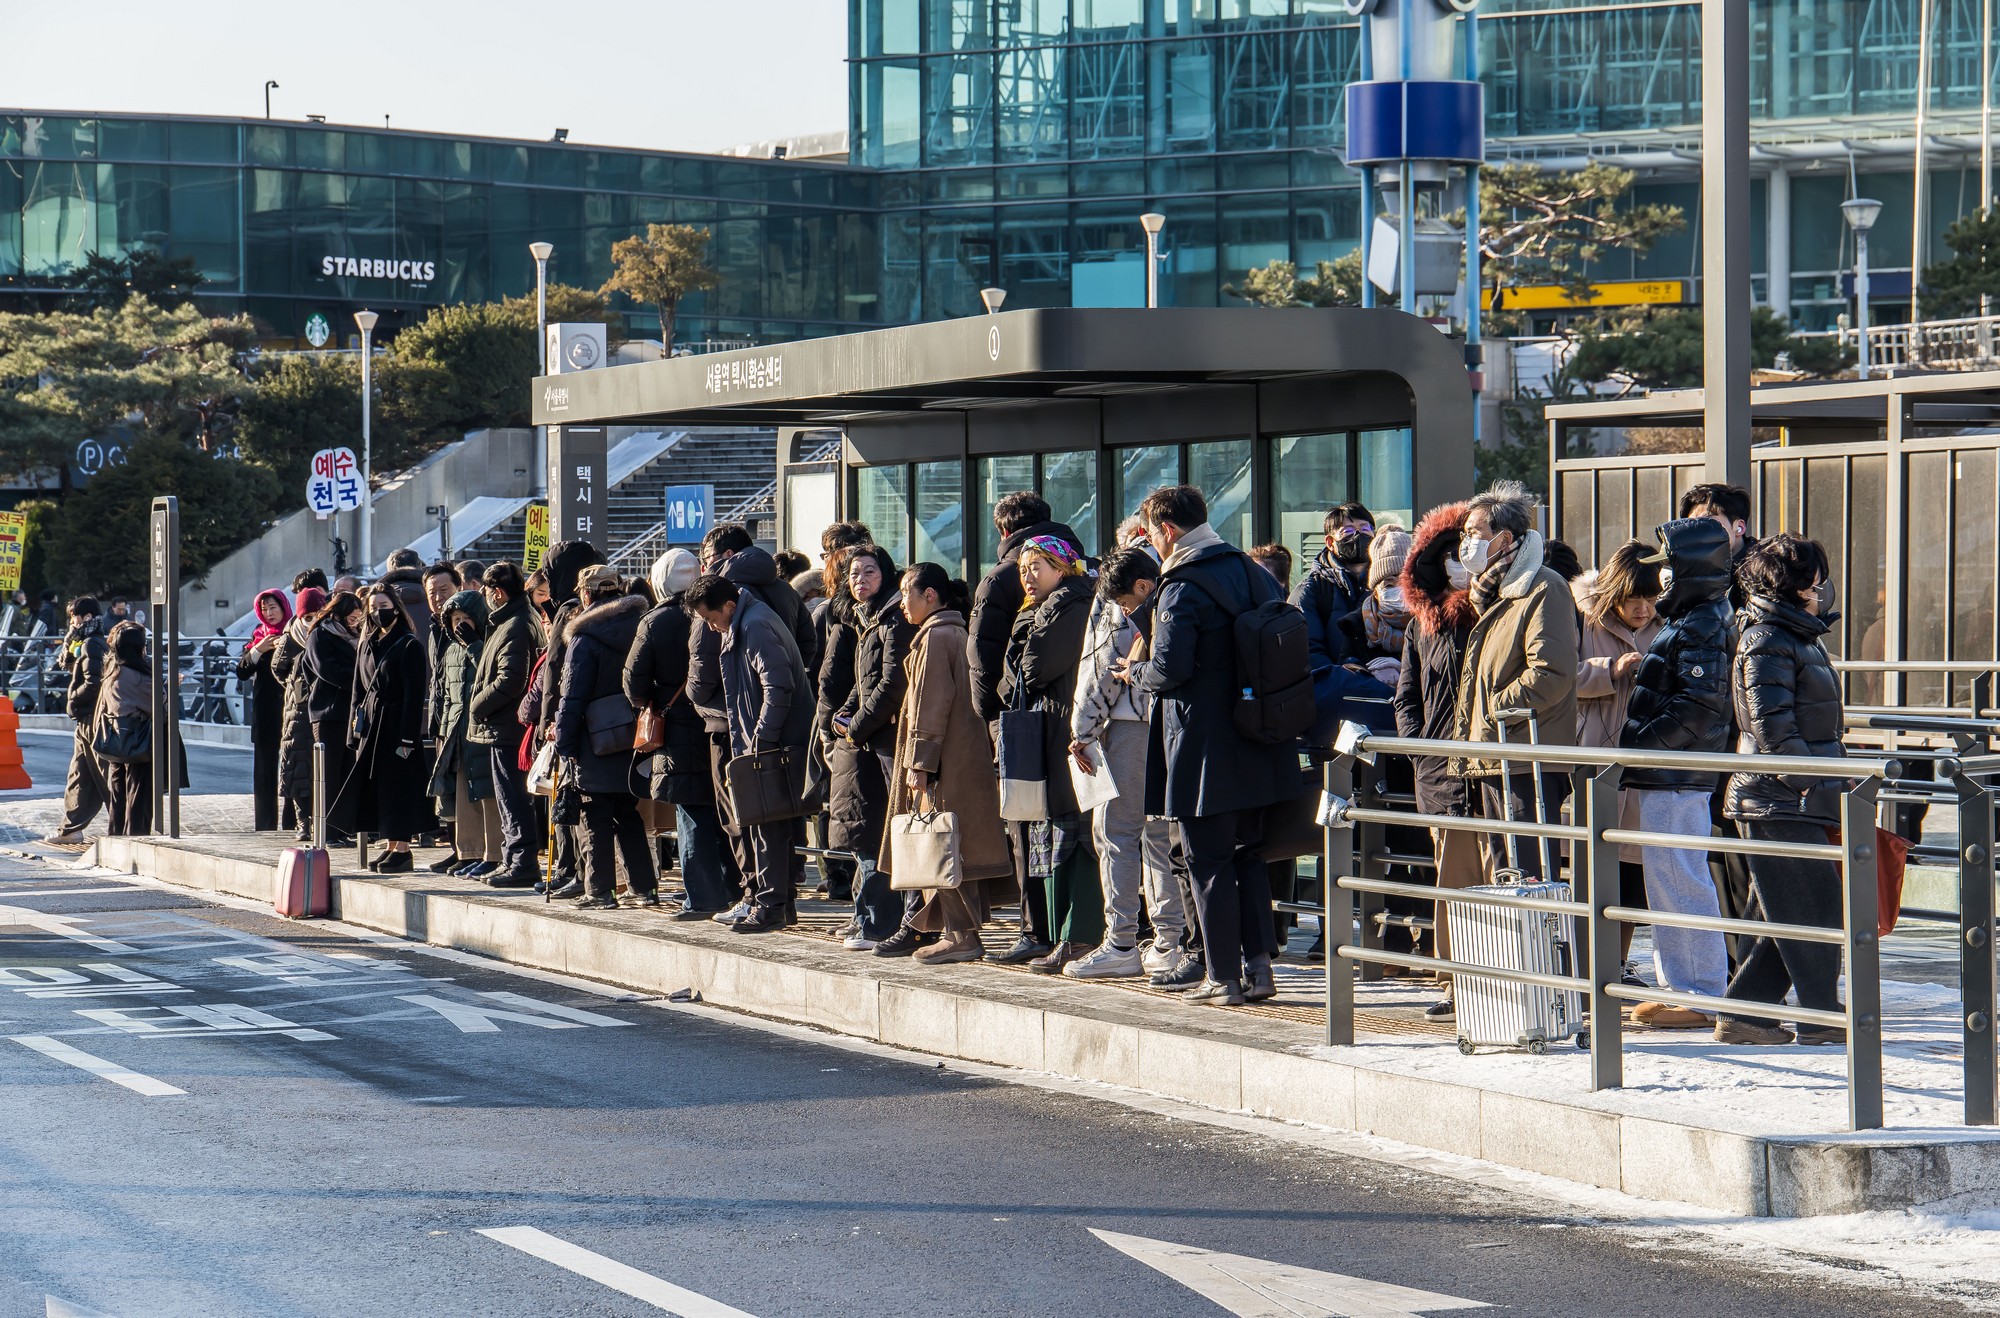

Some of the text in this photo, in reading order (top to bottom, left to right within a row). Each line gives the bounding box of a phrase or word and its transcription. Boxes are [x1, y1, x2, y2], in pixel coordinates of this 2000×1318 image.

[322, 255, 435, 281] STARBUCKS
[705, 354, 782, 394] 서울역 택시환승센터
[315, 451, 353, 479] 예수
[313, 478, 358, 511] 천국
[576, 465, 592, 505] 택시
